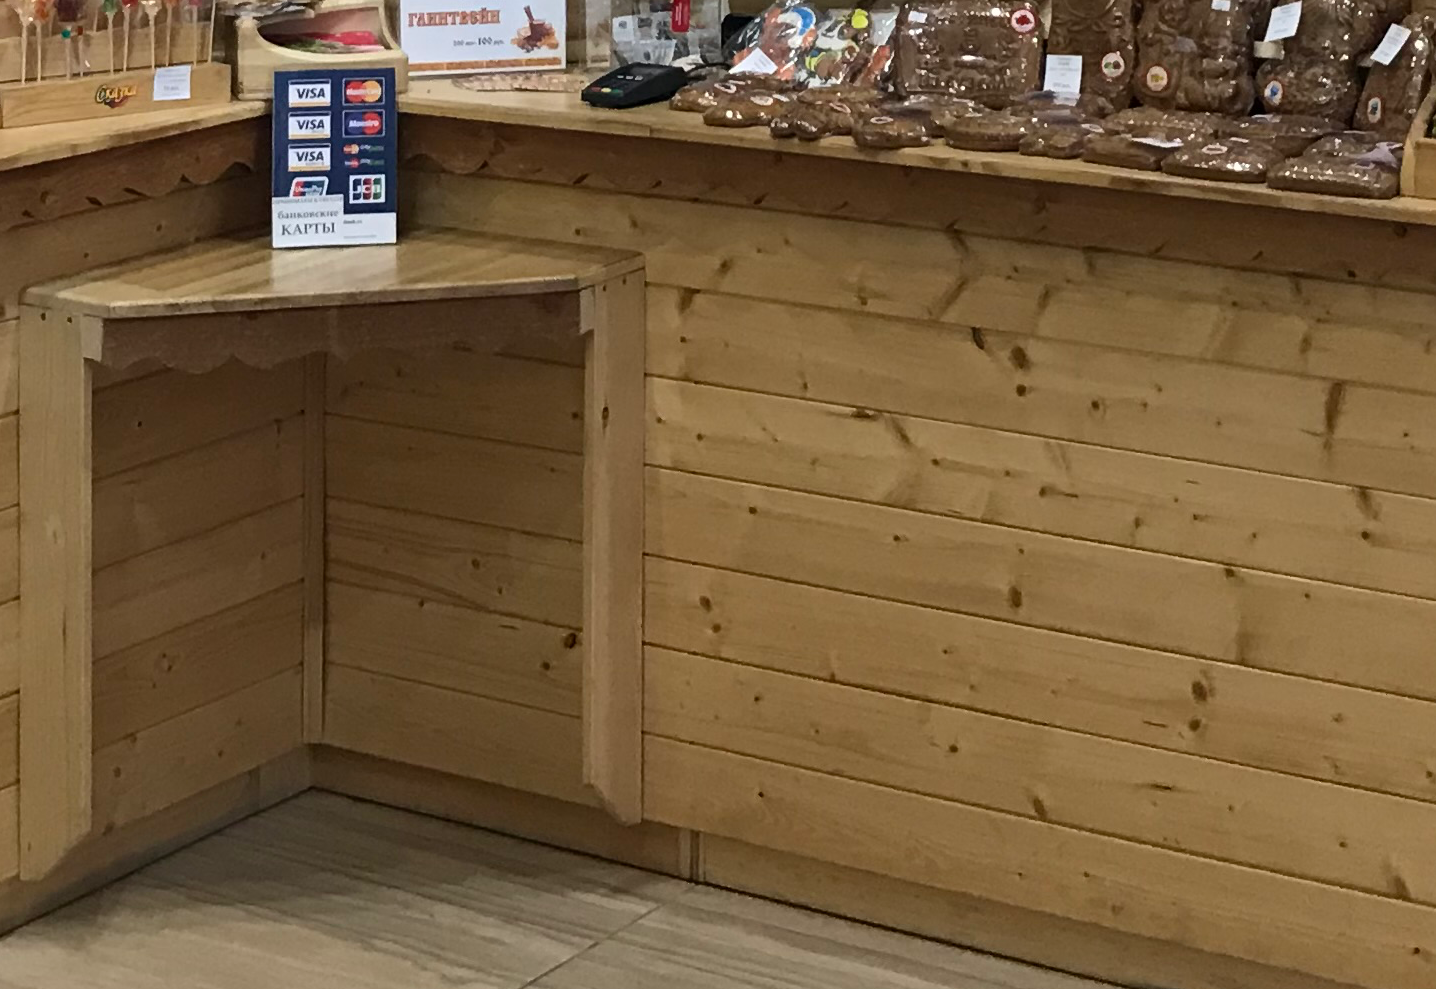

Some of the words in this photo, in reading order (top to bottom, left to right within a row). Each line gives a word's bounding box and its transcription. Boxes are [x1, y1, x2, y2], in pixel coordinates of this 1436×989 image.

[408, 7, 501, 28] ГЛИНТВЕЙН
[478, 37, 493, 46] 100
[296, 87, 326, 99] VISA
[296, 119, 325, 130] VISA
[296, 152, 325, 162] VISA
[277, 210, 339, 219] банковские
[281, 222, 336, 236] КАРТЫ
